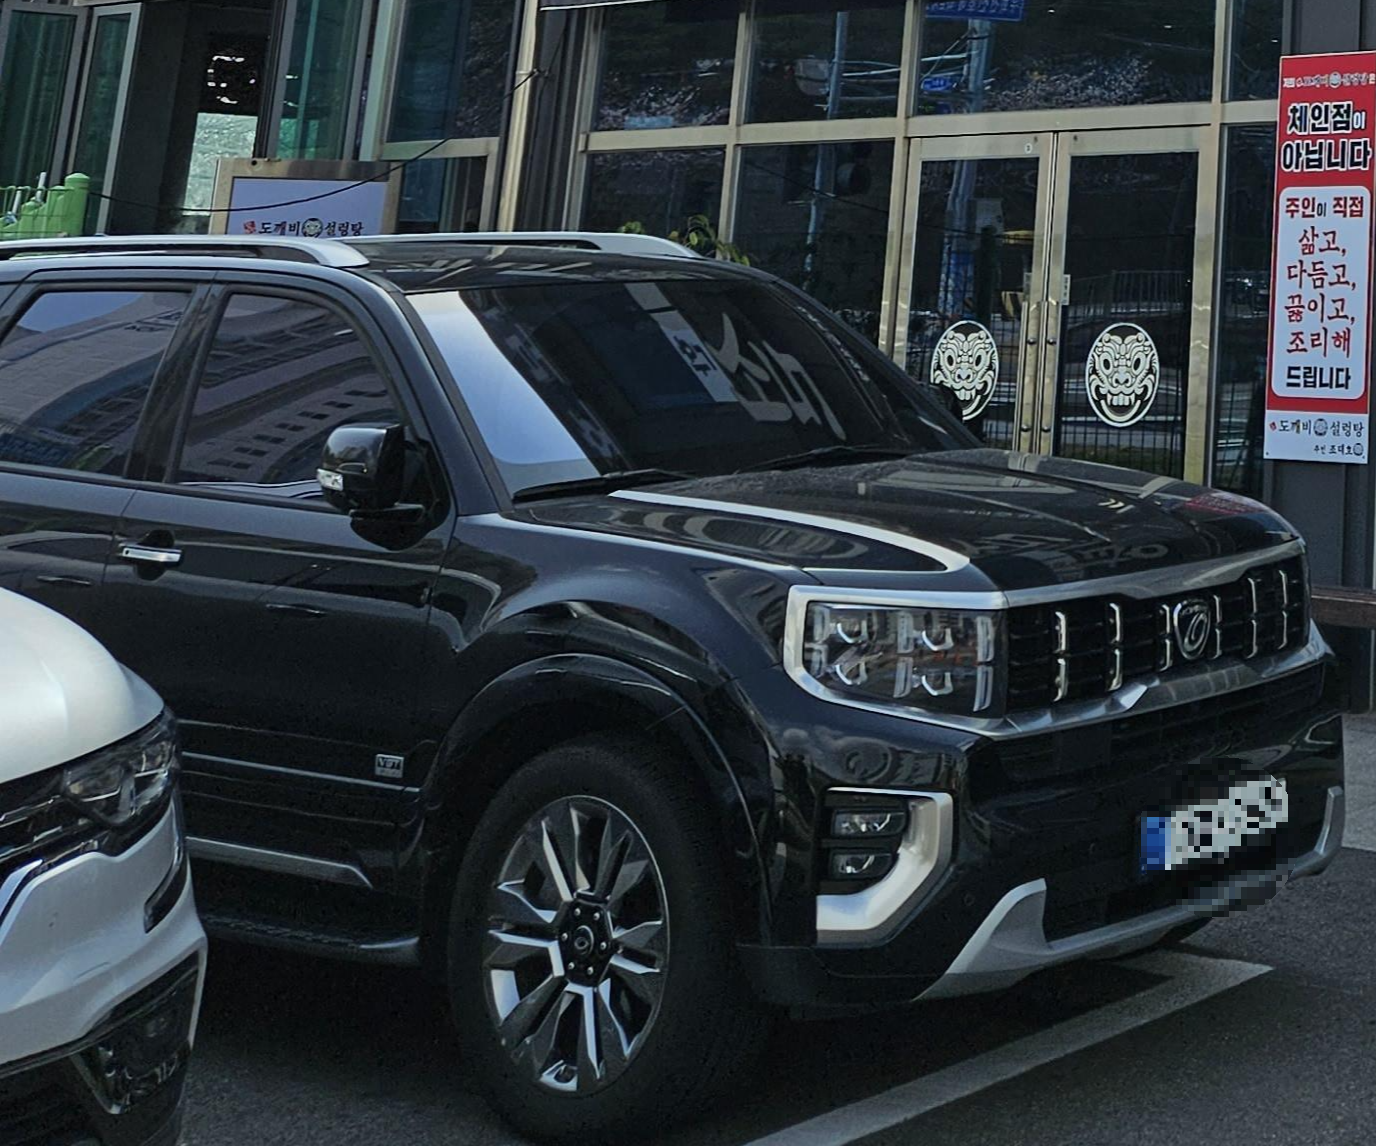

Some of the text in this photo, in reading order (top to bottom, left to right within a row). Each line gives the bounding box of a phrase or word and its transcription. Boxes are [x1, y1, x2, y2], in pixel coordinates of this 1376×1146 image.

[1286, 100, 1367, 136] 체인점이
[1281, 137, 1374, 173] 아닙니다
[1285, 195, 1365, 219] 주인이 직접
[258, 220, 300, 236] 도깨비
[324, 221, 365, 237] 설렁탕
[1298, 225, 1347, 257] 삶고,
[1286, 259, 1357, 291] 다듬고,
[1284, 292, 1356, 326] 끓이고,
[1286, 326, 1352, 359] 조리해
[1285, 365, 1352, 390] 드립니다
[1279, 419, 1312, 435] 도깨비
[1330, 420, 1365, 437] 설렁탕
